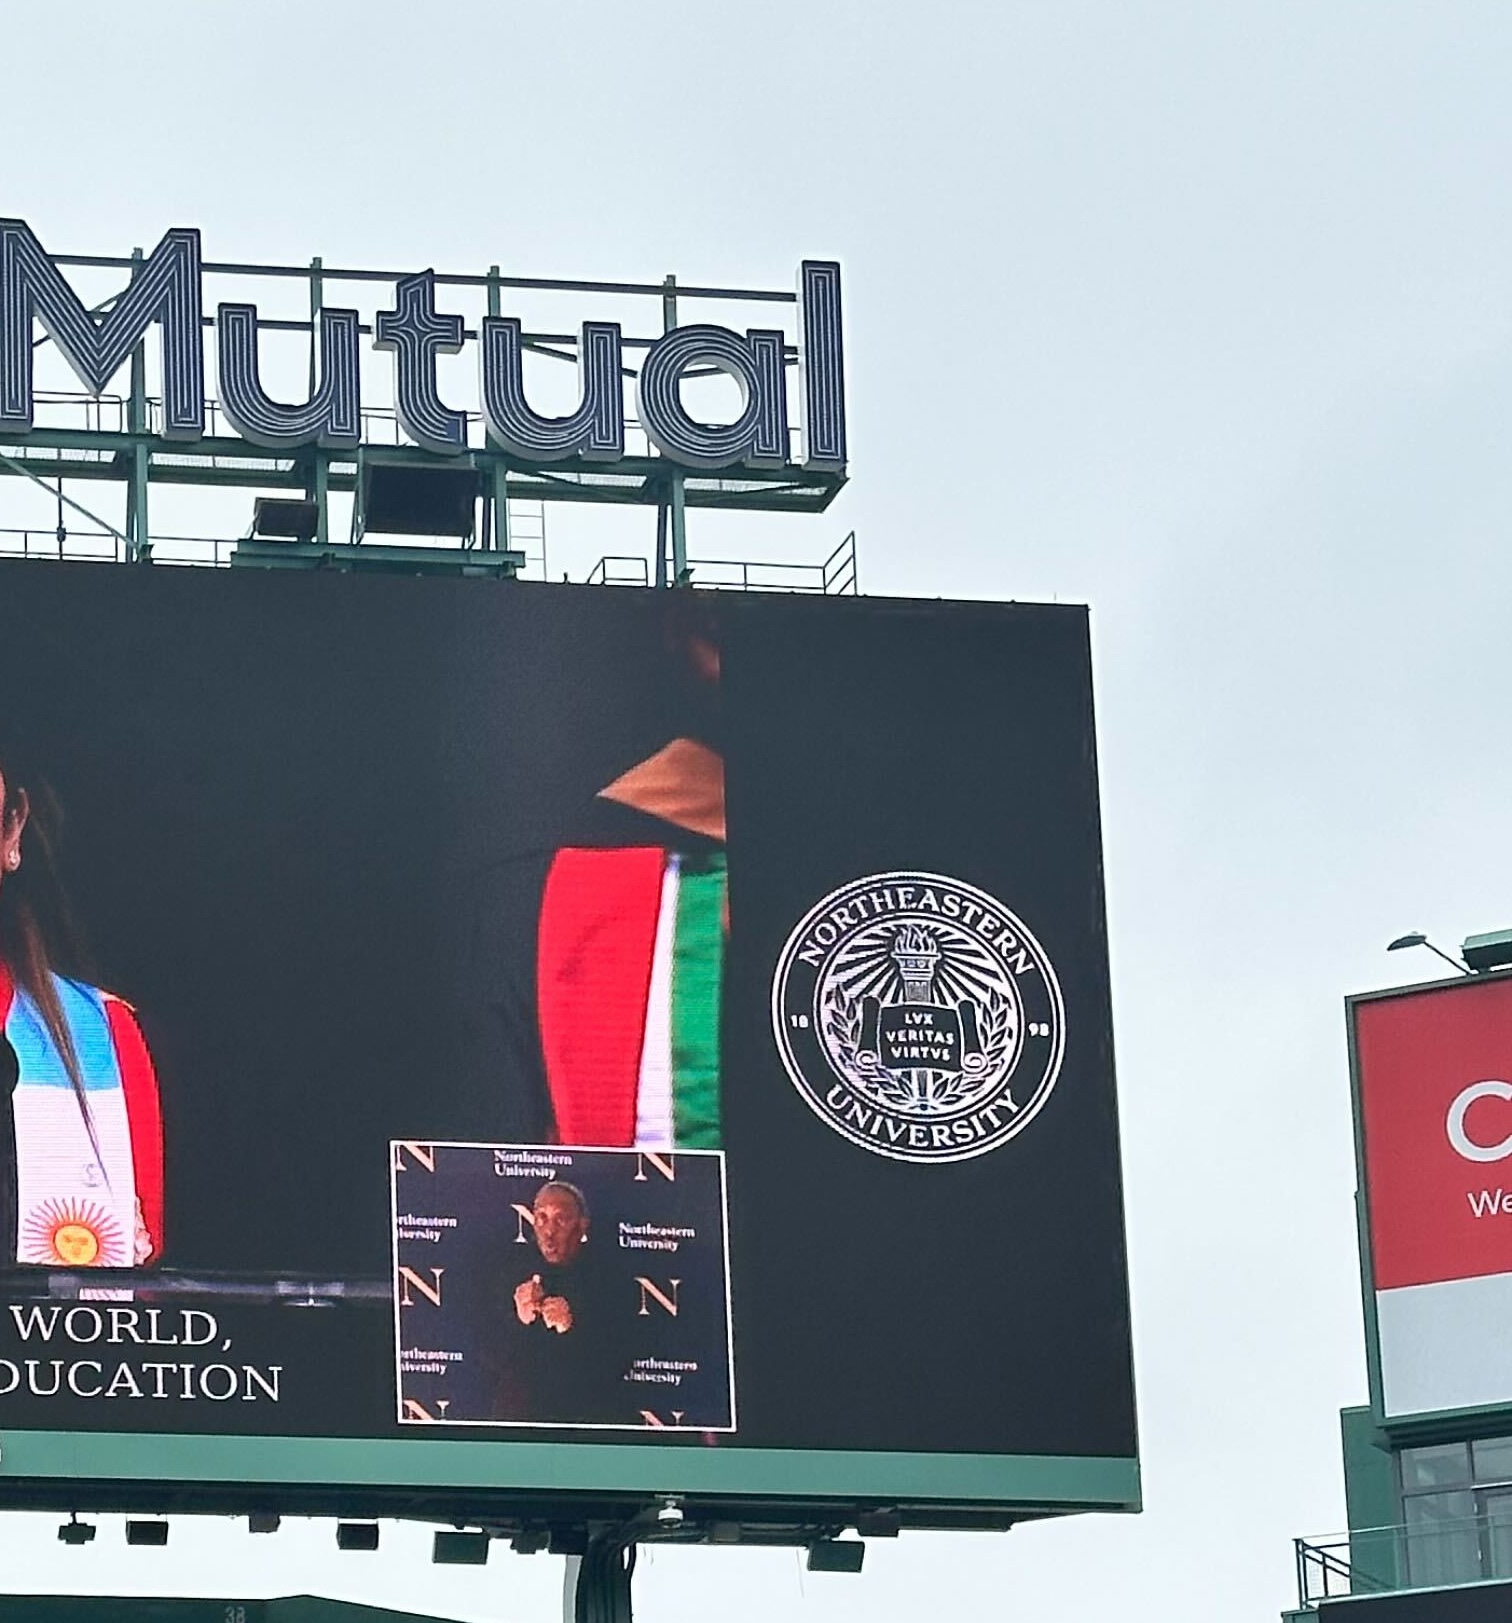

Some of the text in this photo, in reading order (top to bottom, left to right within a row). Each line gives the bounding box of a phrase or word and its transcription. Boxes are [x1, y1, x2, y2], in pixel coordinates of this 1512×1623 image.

[797, 887, 1035, 975] NORTHEASTERN
[904, 1012, 934, 1026] LVX
[886, 1030, 955, 1044] VERITAS
[890, 1046, 951, 1062] VIRTVS
[826, 1084, 1020, 1147] UNIVERSITY
[493, 1150, 573, 1166] Northeastern
[494, 1163, 557, 1180] University
[619, 1222, 696, 1238] Northeastern
[619, 1236, 680, 1252] University
[399, 1266, 445, 1307] N
[634, 1277, 682, 1318] N
[8, 1305, 233, 1352] WORLD,
